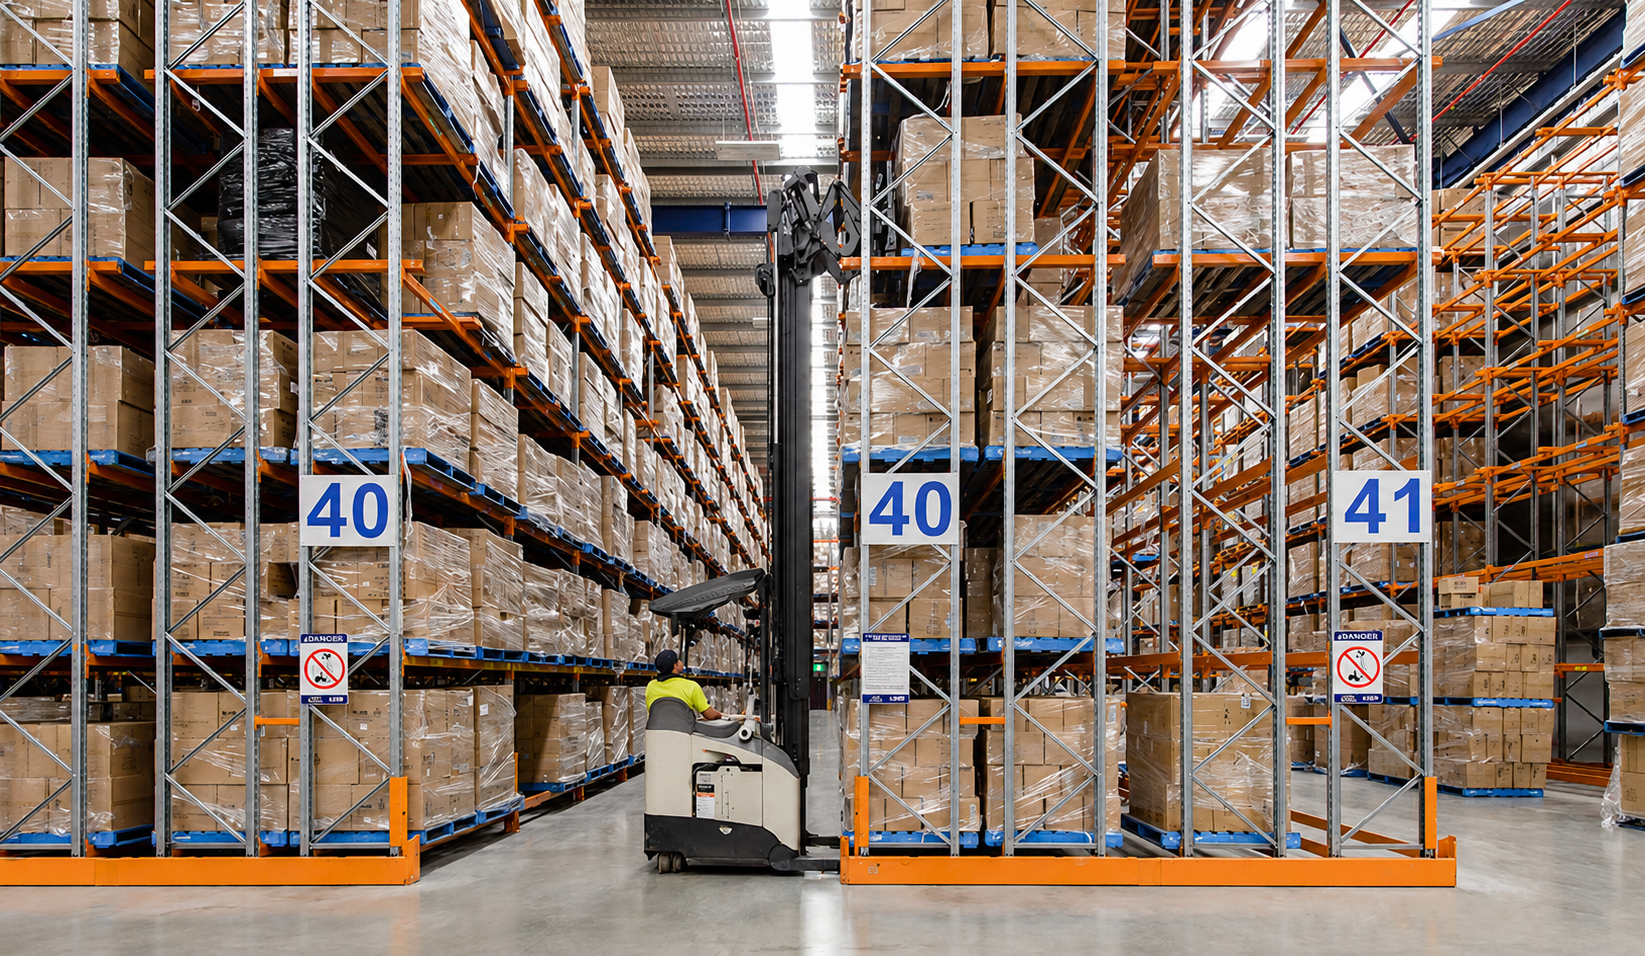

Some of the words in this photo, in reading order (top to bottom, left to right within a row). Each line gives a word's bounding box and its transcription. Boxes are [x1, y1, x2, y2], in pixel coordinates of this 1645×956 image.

[306, 482, 389, 539] 40
[869, 480, 952, 537] 40
[1344, 477, 1422, 534] 41
